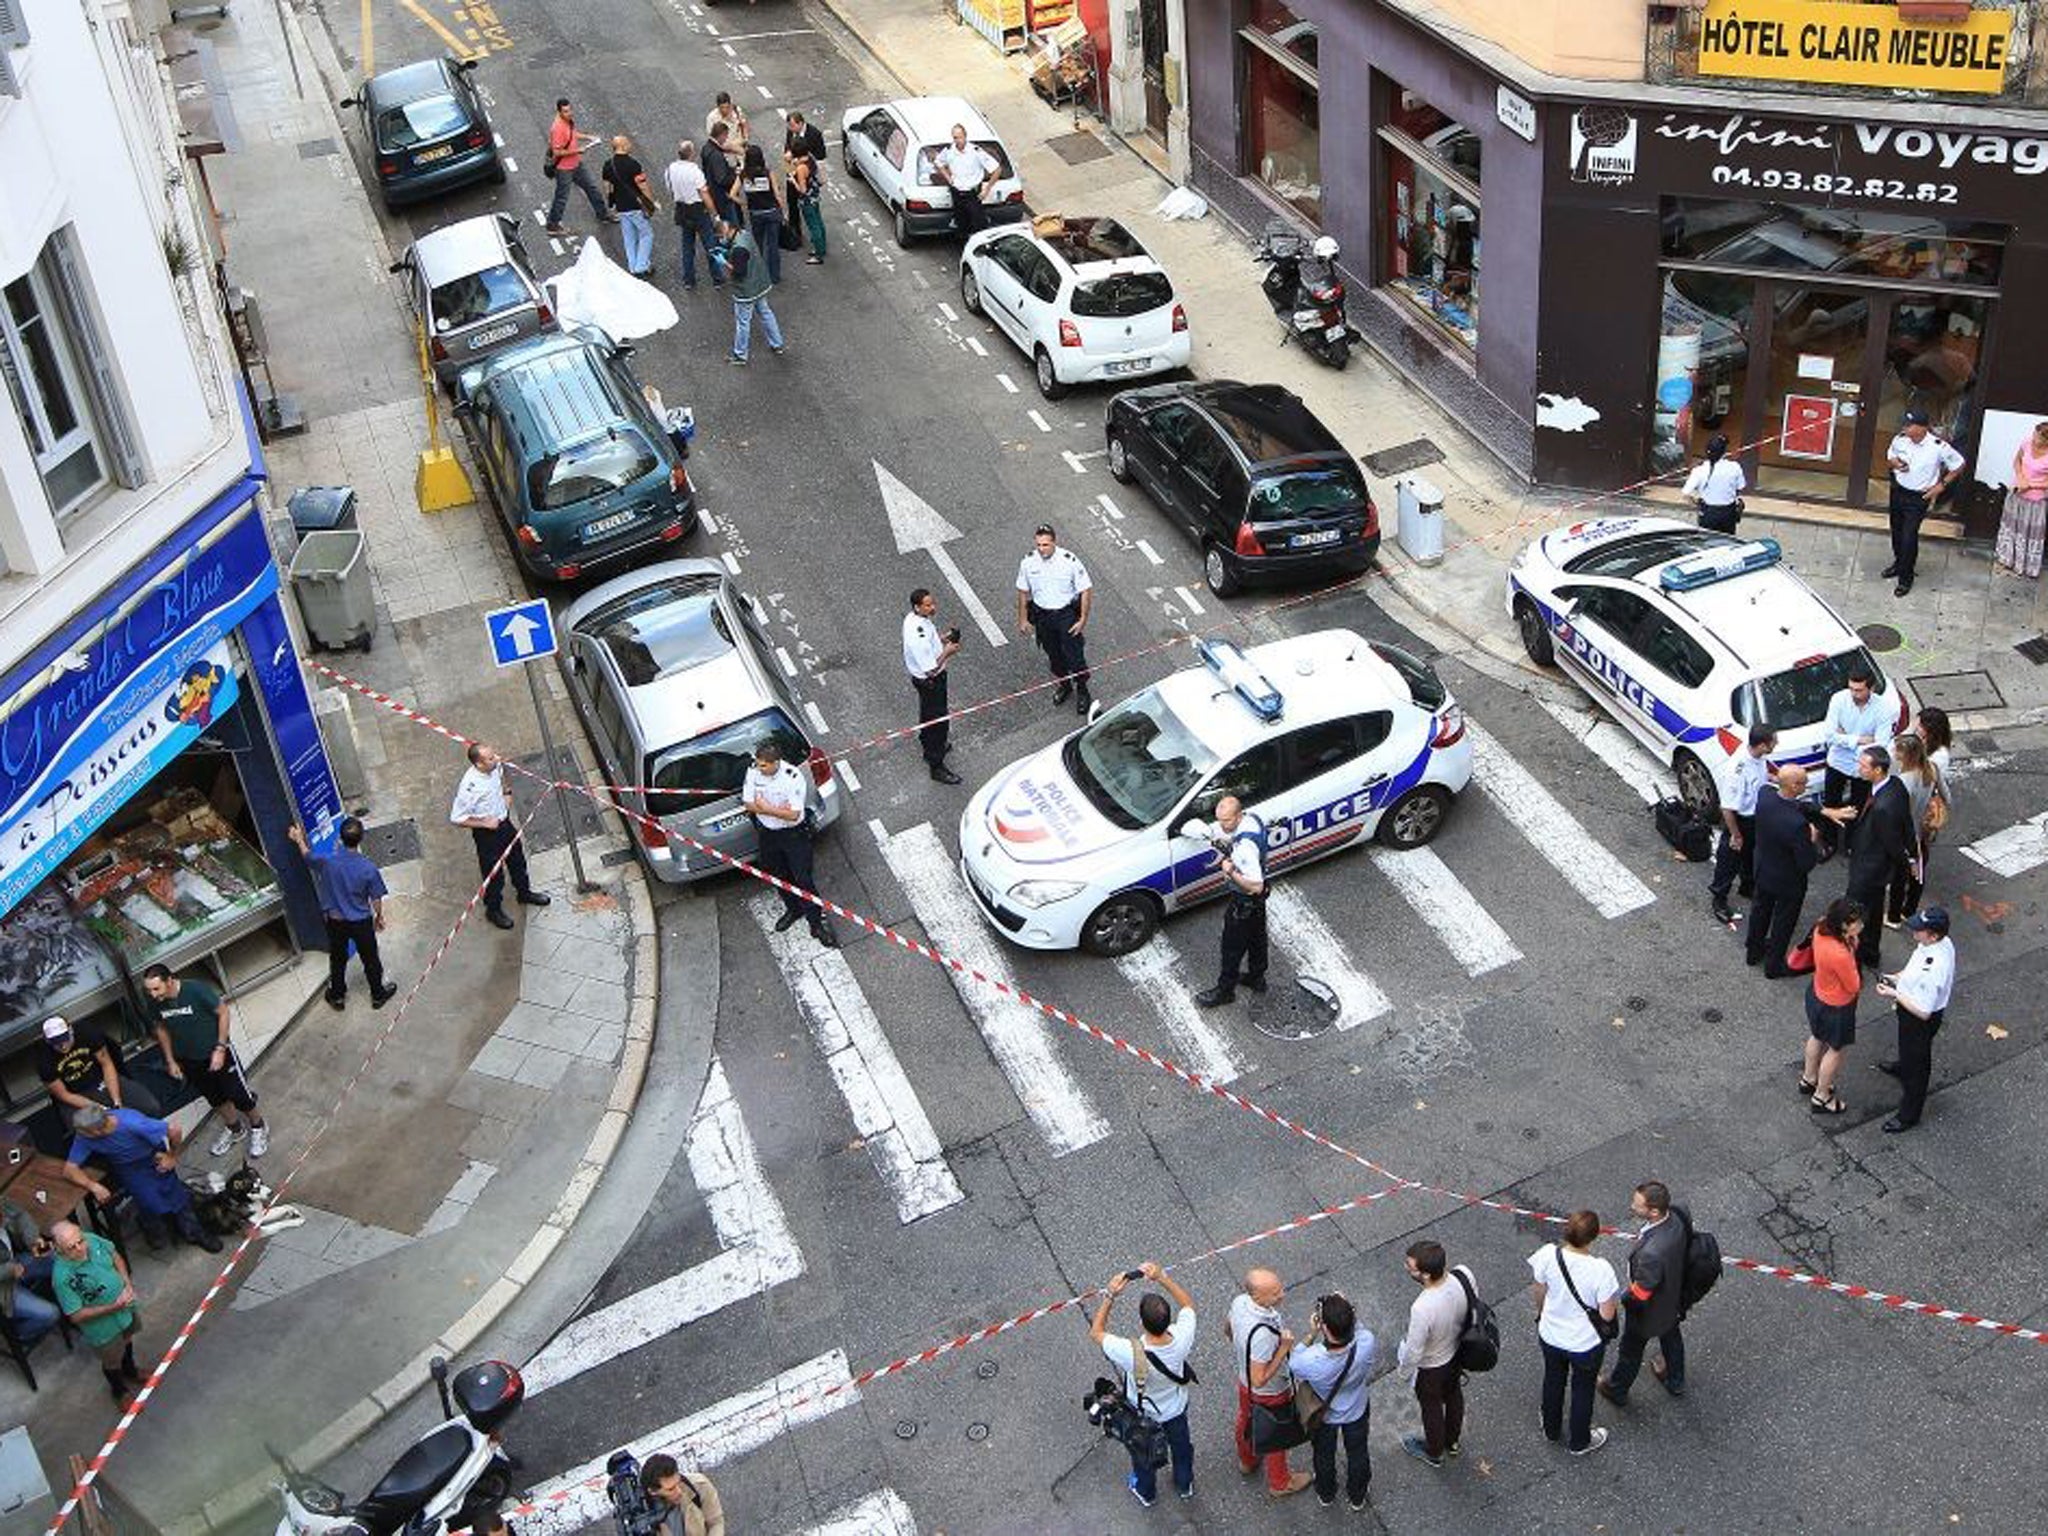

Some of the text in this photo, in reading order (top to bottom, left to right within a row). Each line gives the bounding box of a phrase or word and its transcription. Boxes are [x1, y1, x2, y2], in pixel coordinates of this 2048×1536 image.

[1702, 11, 2006, 70] HÔTEL CLAIR MEUBLE
[1655, 114, 1832, 155] infini
[1592, 156, 1632, 171] INFINI
[1711, 165, 1959, 205] 04.93.82.82.82
[1573, 632, 1656, 717] POLICE
[37, 716, 157, 835] Poissons
[1043, 781, 1083, 825] POLICE
[1267, 790, 1372, 849] OLICE
